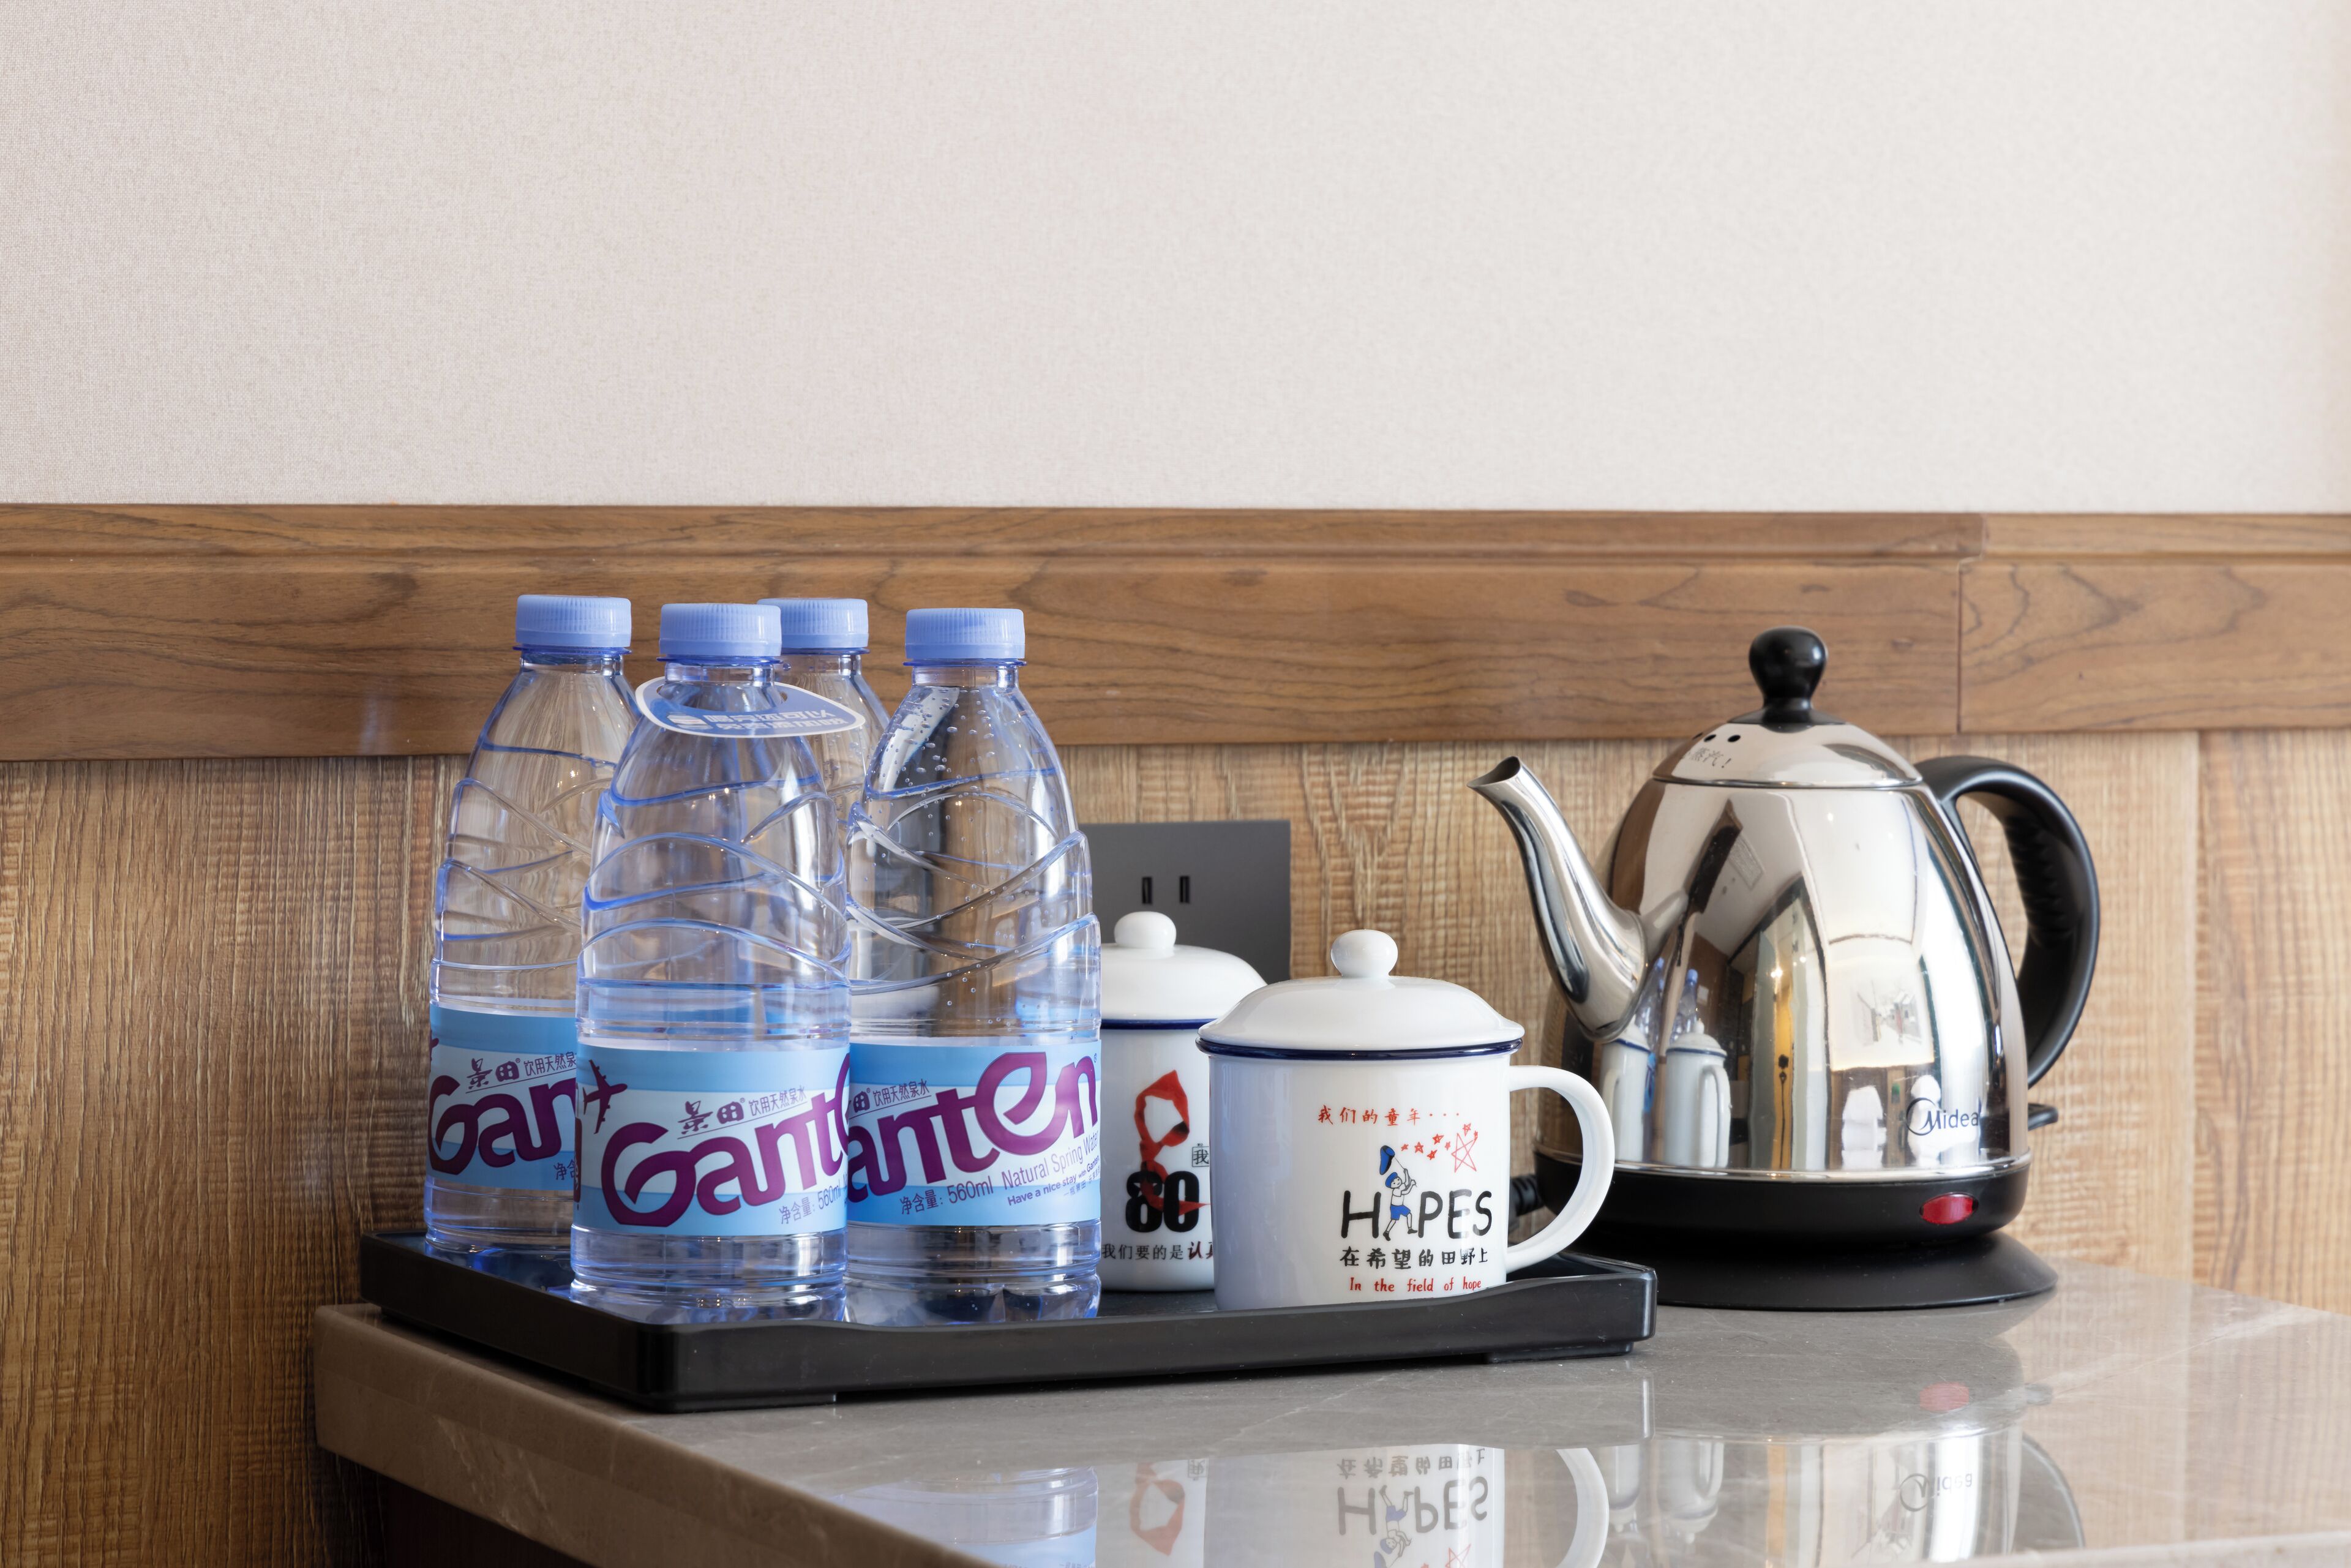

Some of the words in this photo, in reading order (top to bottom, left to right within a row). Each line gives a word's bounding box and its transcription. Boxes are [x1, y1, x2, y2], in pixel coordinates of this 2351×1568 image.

[523, 1051, 576, 1076] 饮用天然泉
[678, 1100, 744, 1135] 景田
[748, 1084, 807, 1116] 饮用天然泉水
[849, 1091, 870, 1113] 田
[873, 1079, 929, 1106] 饮用天然泉水
[1919, 1109, 1979, 1130] Midea
[947, 1176, 993, 1205] 560ml
[1001, 1157, 1049, 1190] Natural
[1051, 1146, 1083, 1174] Spring
[1083, 1130, 1098, 1155] Water
[1193, 1149, 1209, 1165] 我
[817, 1179, 841, 1210] 560ml
[1007, 1191, 1033, 1206] Have
[1043, 1183, 1061, 1195] nice
[1062, 1174, 1077, 1187] stay
[1078, 1170, 1087, 1179] with
[1125, 1171, 1199, 1232] 80
[1340, 1246, 1488, 1269] 在希望的田野上
[1349, 1277, 1362, 1291] In
[1374, 1278, 1395, 1292] the
[1407, 1278, 1434, 1292] field
[1444, 1276, 1454, 1291] of
[1463, 1276, 1482, 1290] hope
